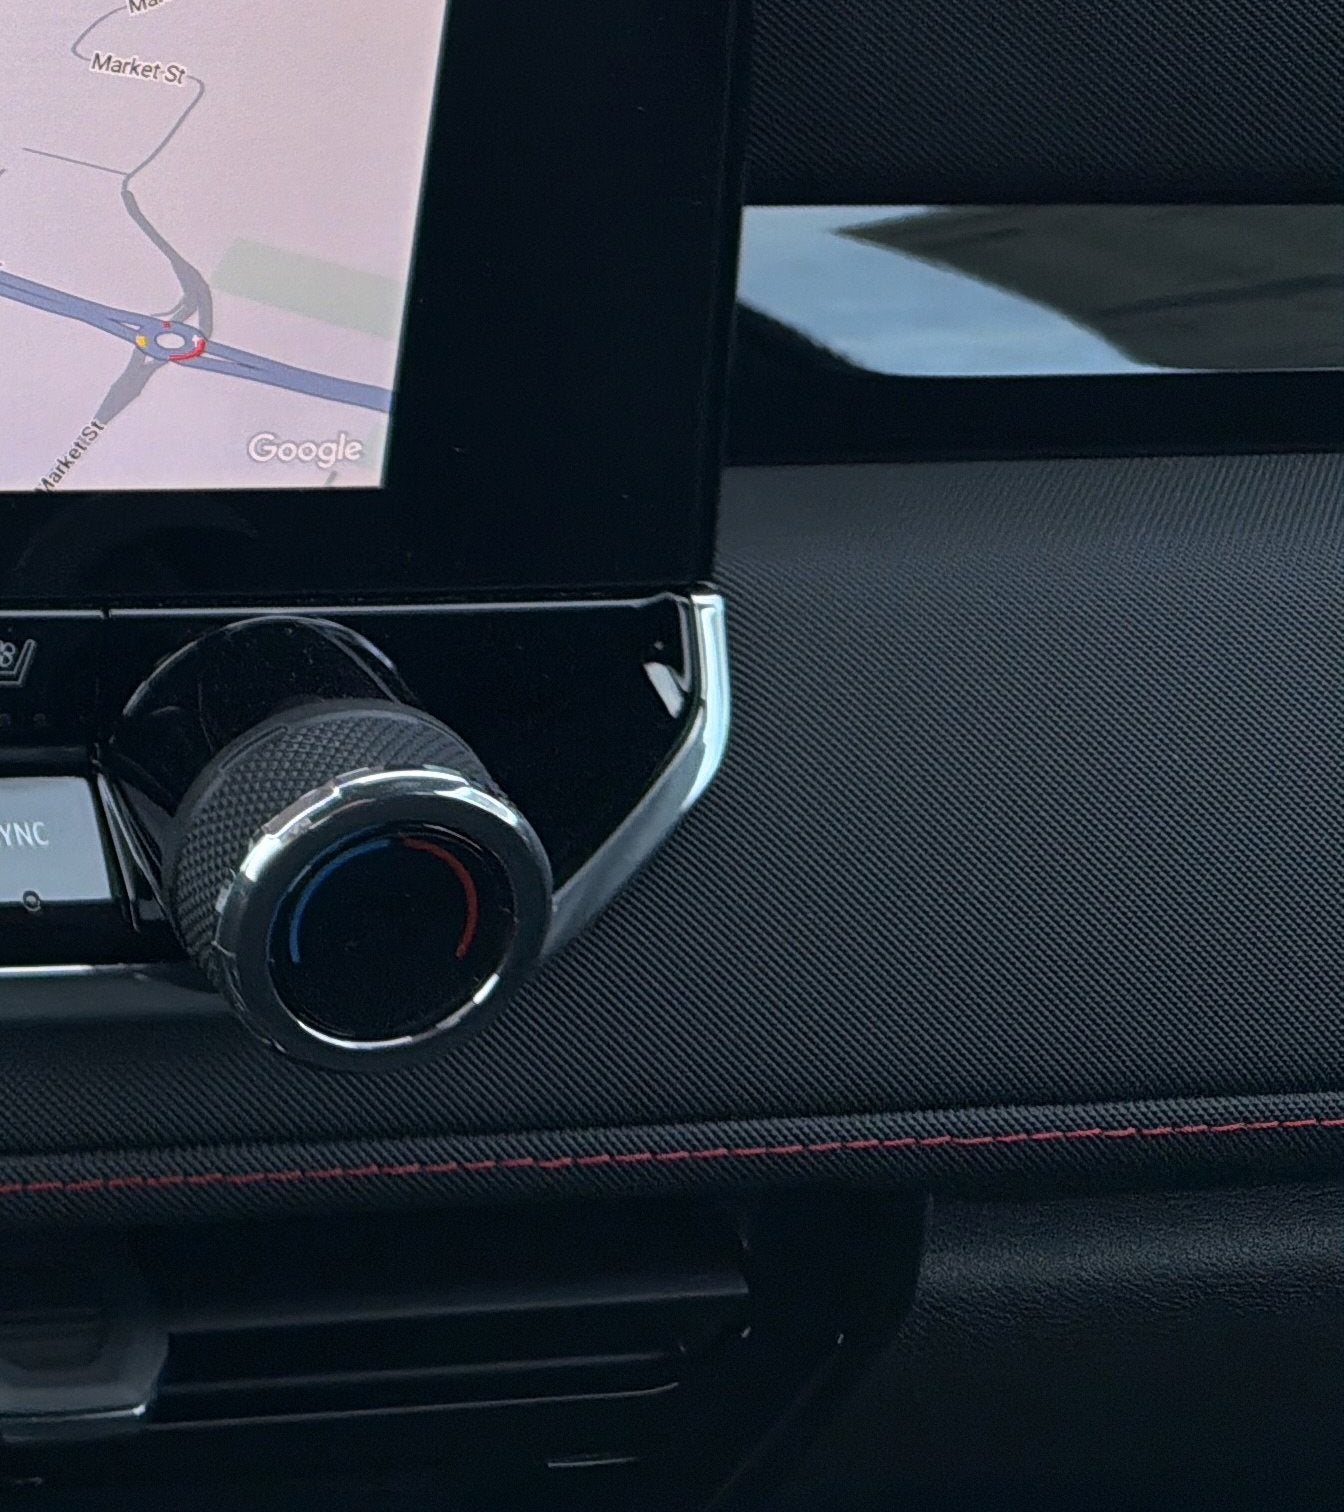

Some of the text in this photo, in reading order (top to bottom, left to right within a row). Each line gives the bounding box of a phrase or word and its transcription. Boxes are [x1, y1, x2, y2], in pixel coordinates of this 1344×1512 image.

[90, 53, 186, 84] Market St
[35, 419, 106, 493] Market St
[248, 432, 363, 468] Google
